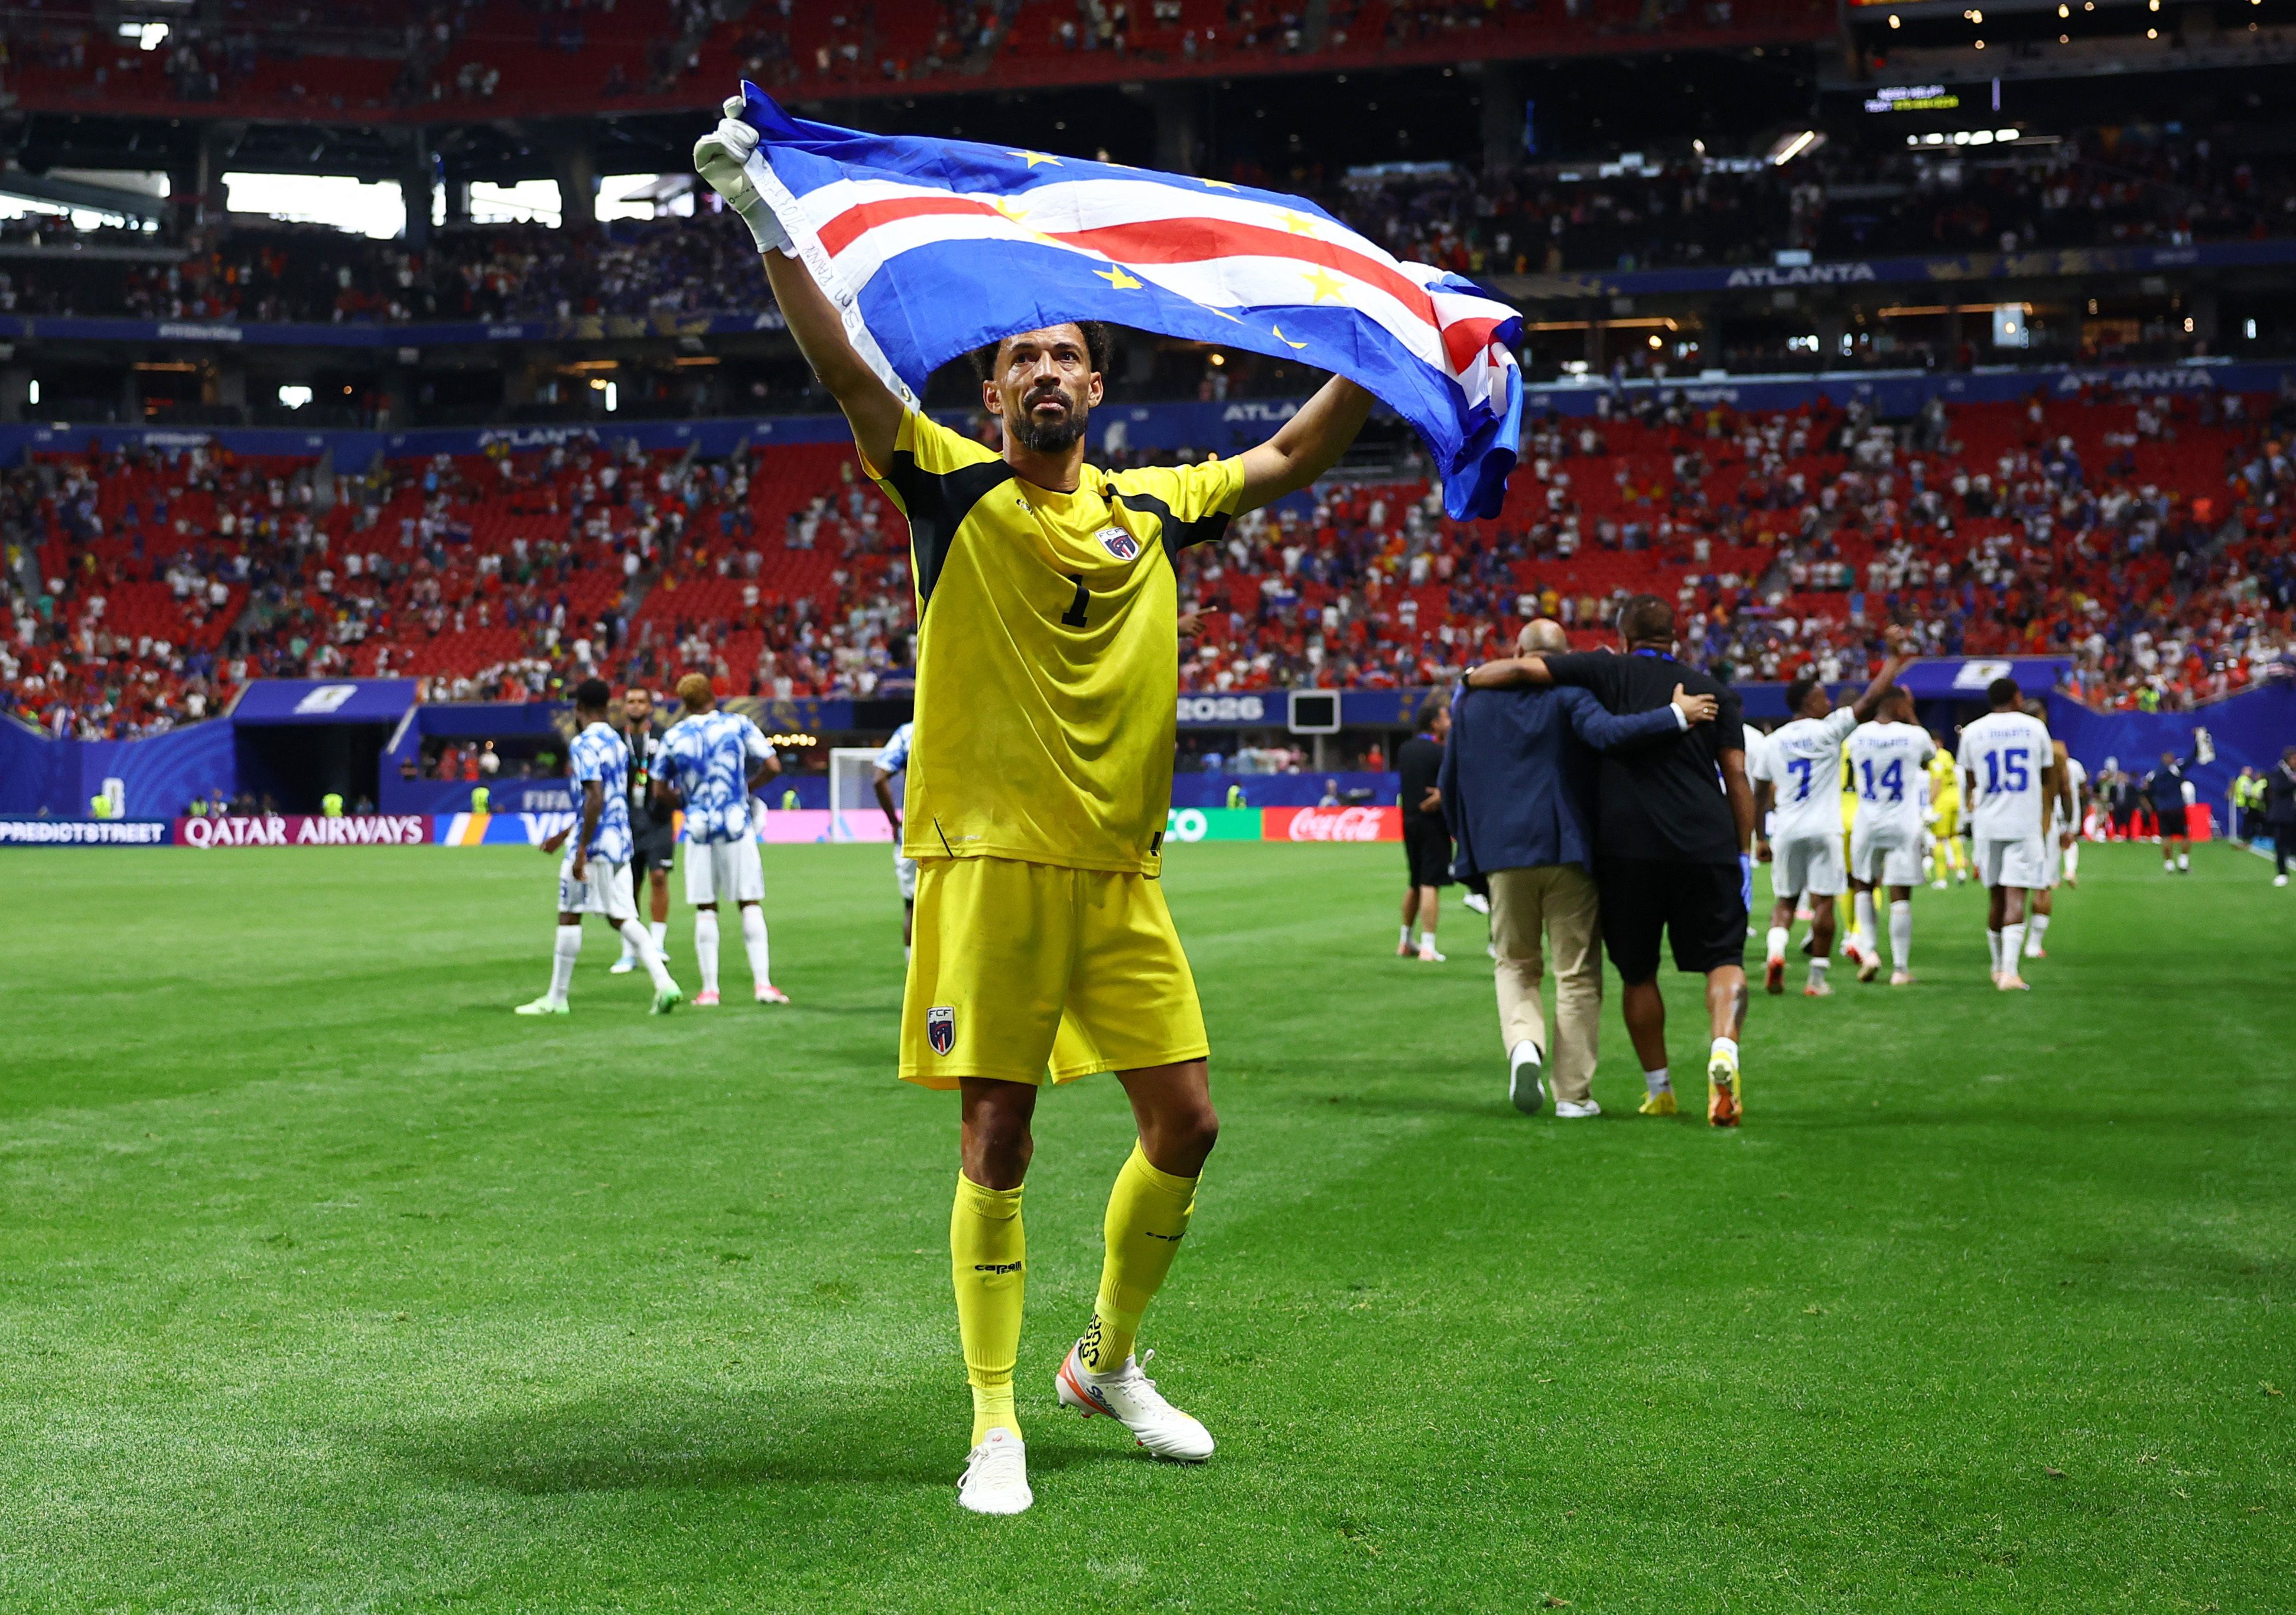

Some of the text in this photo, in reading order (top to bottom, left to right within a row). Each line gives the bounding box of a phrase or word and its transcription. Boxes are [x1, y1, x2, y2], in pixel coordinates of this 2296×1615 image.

[1726, 263, 1876, 287] ATLANTA
[2057, 369, 2214, 392] ATANTA
[1223, 403, 1301, 423] ATLA
[1061, 574, 1090, 628] 1
[1787, 758, 1812, 802] 7
[1861, 758, 1904, 802] 14
[1984, 748, 2030, 793] 15
[522, 790, 573, 811] FIFA
[0, 821, 165, 843] PREDICTSTREET
[184, 815, 424, 849] QATAR AIRWAYS
[519, 811, 577, 844] VI
[929, 1009, 951, 1018] FCF
